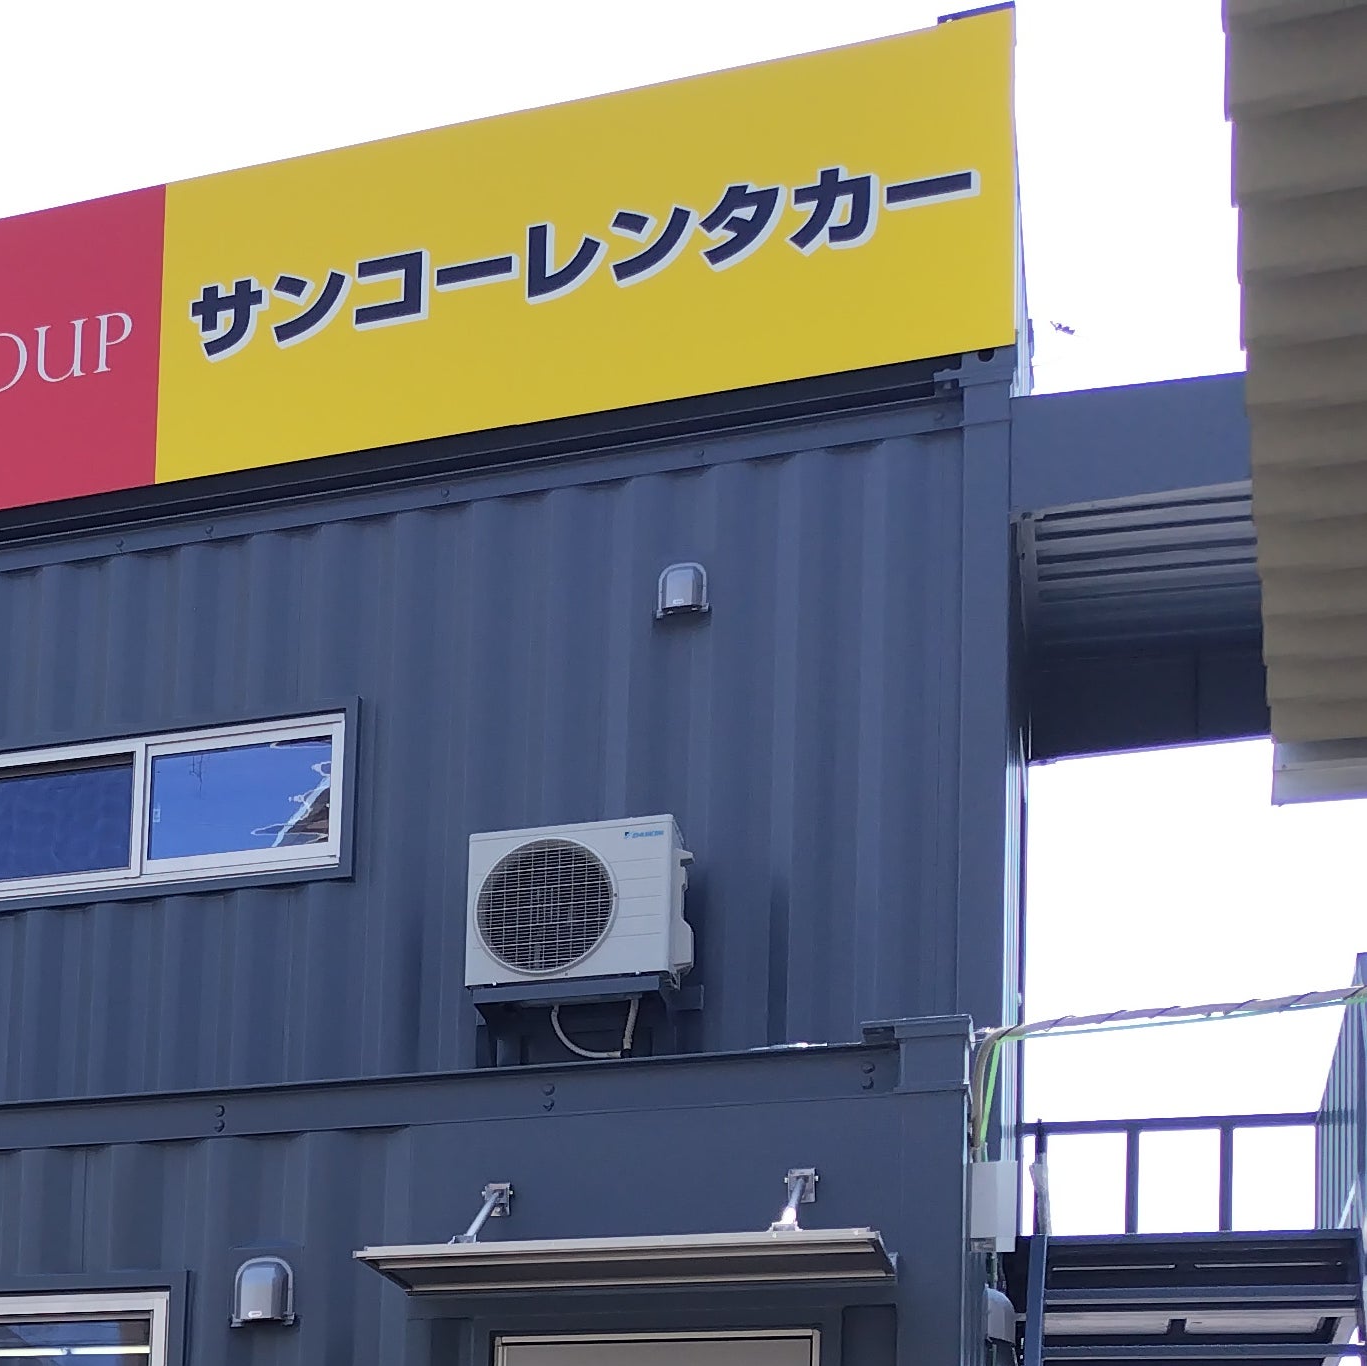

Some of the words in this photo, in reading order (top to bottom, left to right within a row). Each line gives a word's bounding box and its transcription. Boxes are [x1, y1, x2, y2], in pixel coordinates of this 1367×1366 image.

[191, 166, 980, 361] サンコーレンタカー
